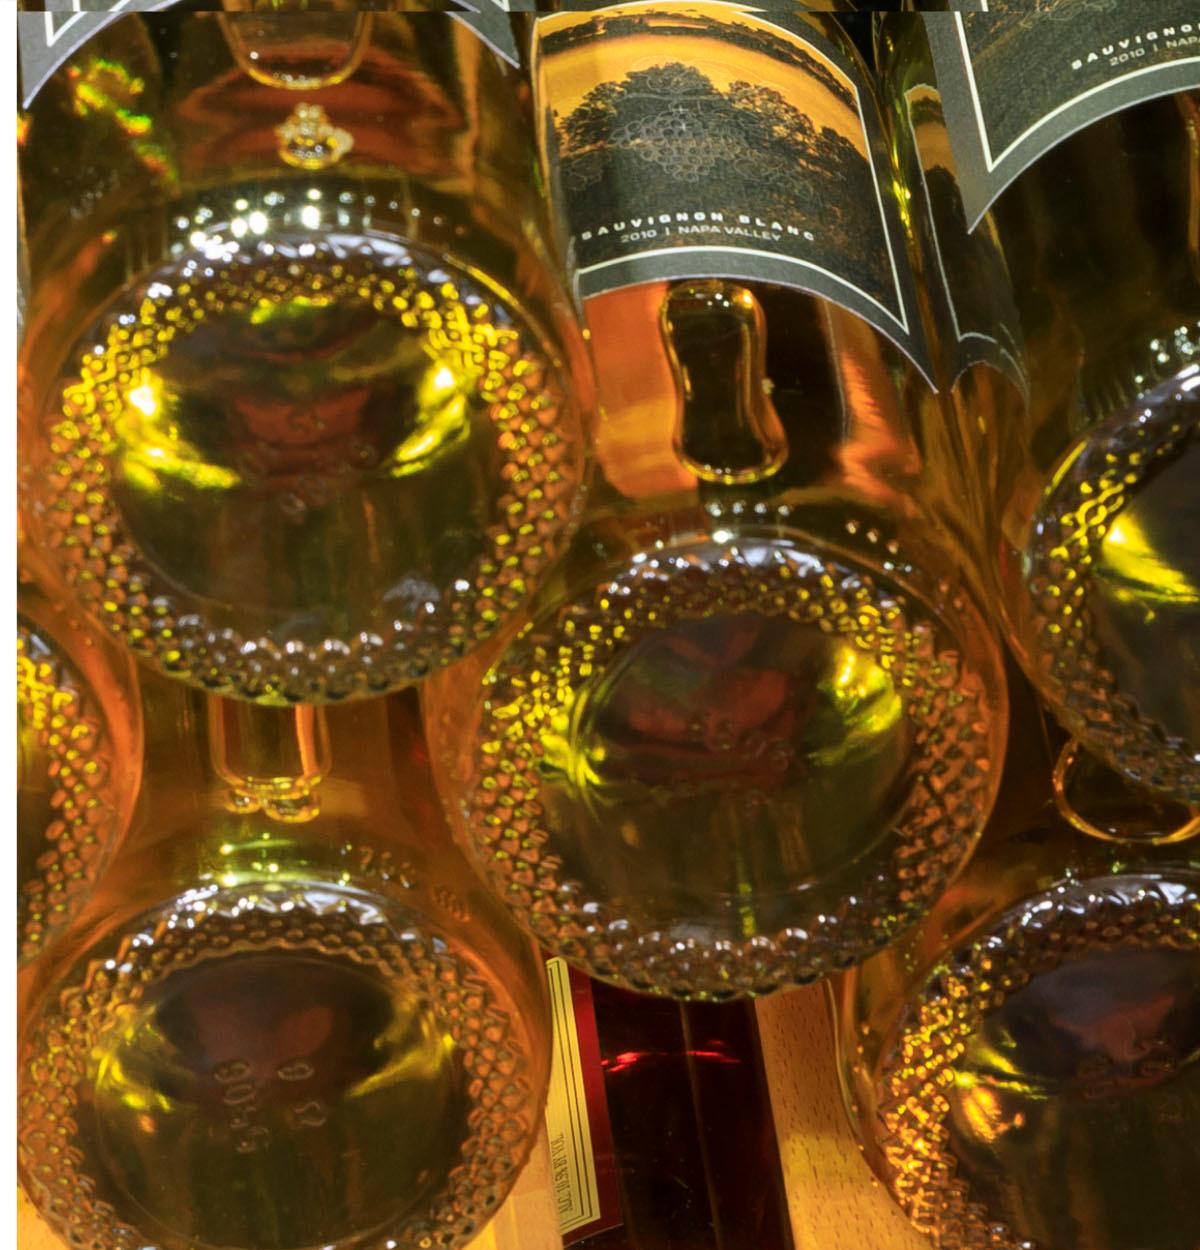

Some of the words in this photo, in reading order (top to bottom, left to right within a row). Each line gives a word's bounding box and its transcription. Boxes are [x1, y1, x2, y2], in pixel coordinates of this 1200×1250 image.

[1109, 47, 1145, 66] 2010
[581, 211, 724, 241] SAUVIGNON
[739, 214, 815, 241] BLANC
[620, 229, 657, 243] 2010
[678, 225, 721, 237] NAPA
[724, 225, 782, 242] VALLEY
